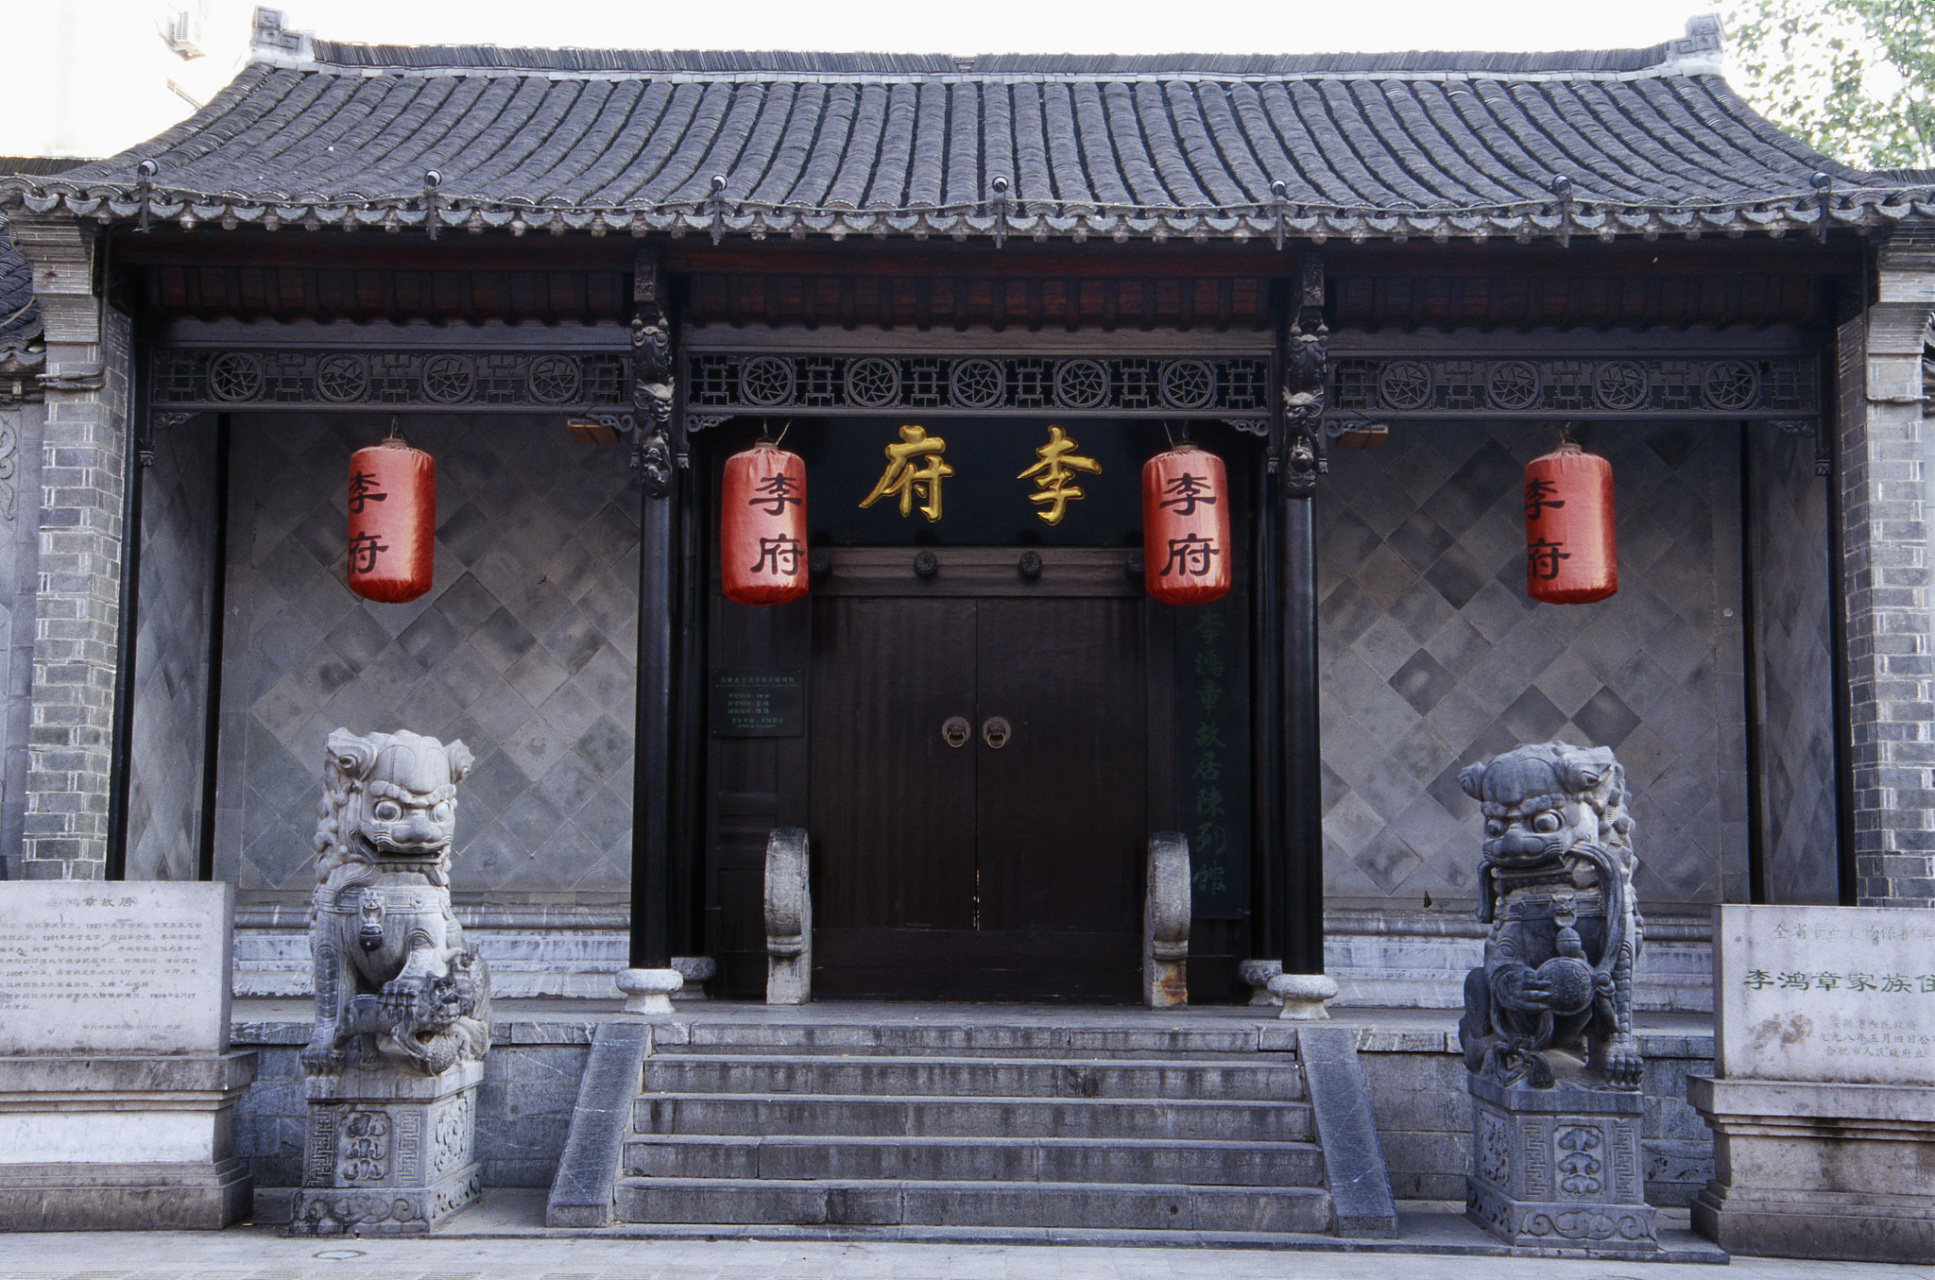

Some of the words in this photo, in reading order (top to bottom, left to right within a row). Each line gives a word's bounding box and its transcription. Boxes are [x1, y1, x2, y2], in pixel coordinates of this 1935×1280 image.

[349, 471, 389, 574] 李府
[749, 472, 804, 576] 李府
[858, 425, 1101, 525] 李府
[1159, 472, 1219, 576] 李府
[1524, 478, 1571, 581] 李府
